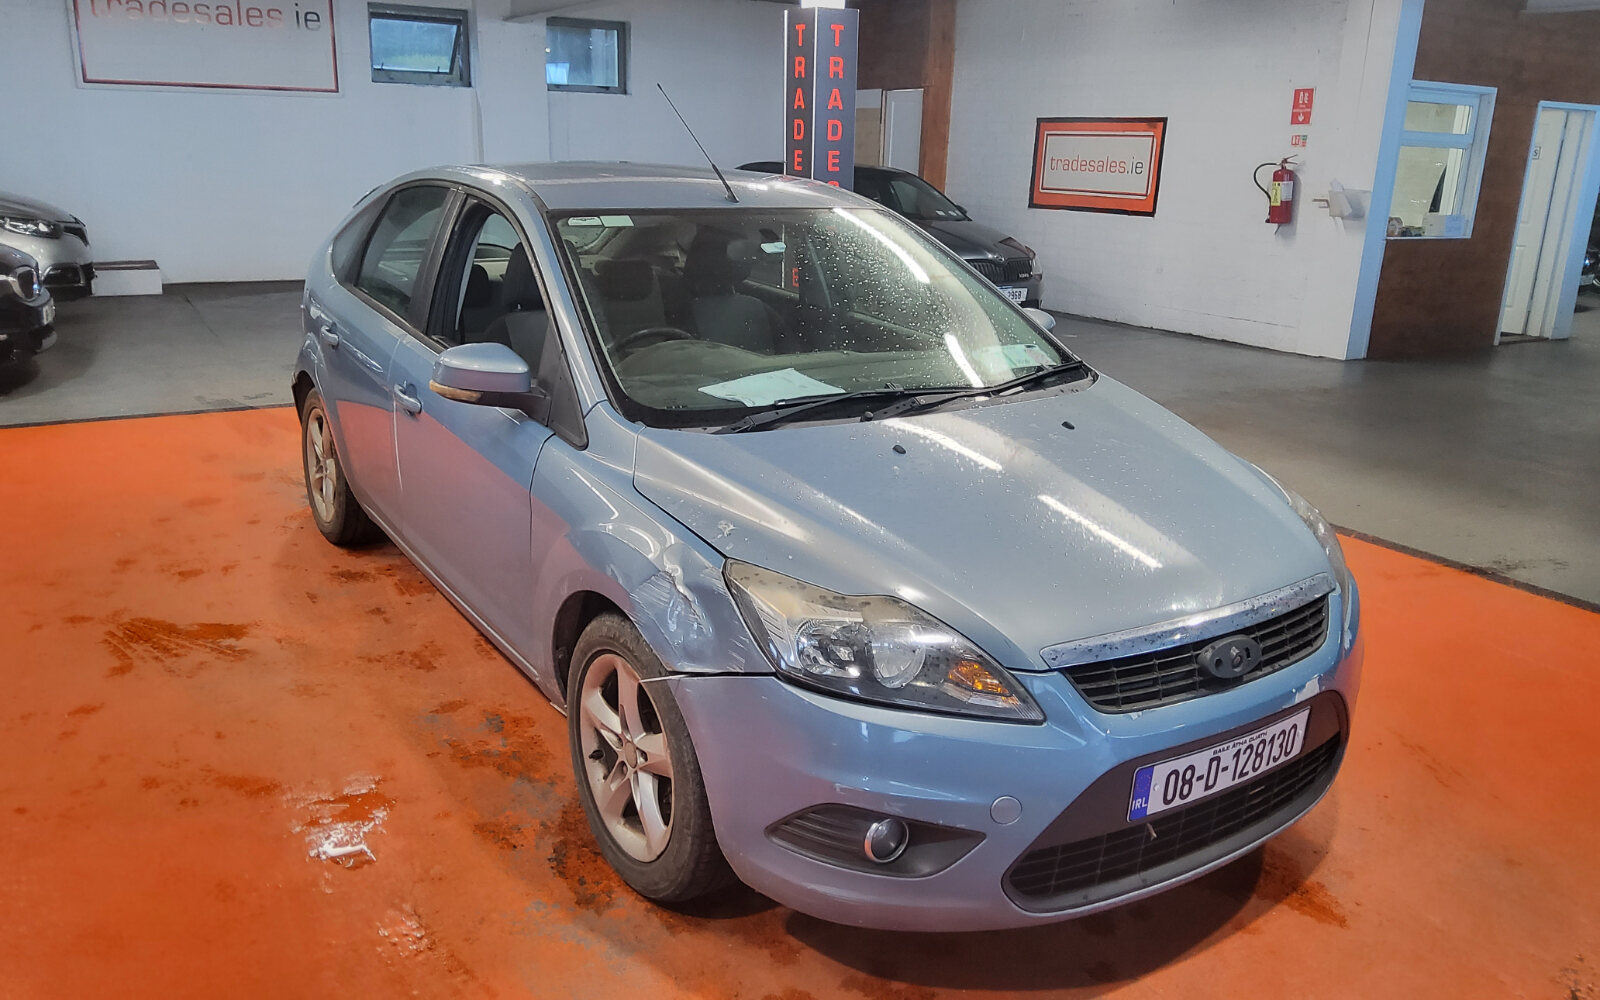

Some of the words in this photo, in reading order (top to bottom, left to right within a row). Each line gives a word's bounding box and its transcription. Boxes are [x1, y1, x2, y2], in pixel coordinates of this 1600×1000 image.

[793, 24, 806, 171] TRADE
[1050, 154, 1144, 175] tradesales.ie
[1162, 723, 1298, 806] 08-D-128130
[1131, 797, 1148, 811] IRL
